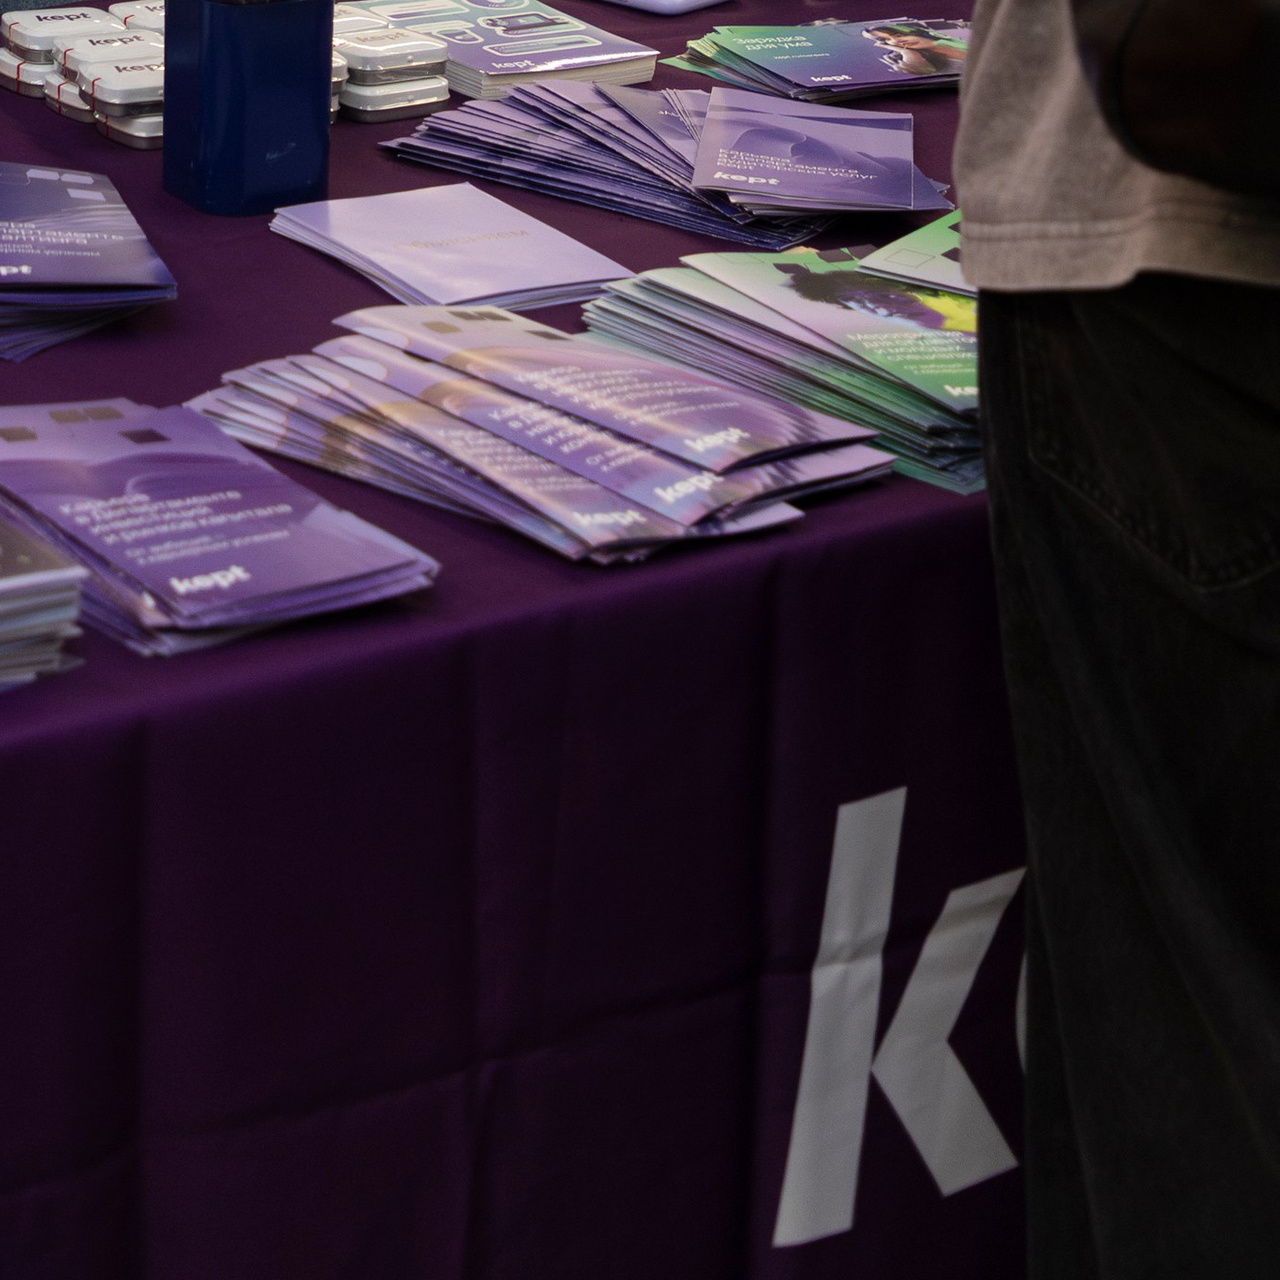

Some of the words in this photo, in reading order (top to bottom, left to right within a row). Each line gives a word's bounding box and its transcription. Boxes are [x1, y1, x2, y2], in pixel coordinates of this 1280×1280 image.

[35, 12, 91, 22] kept
[88, 35, 145, 46] kept
[491, 59, 536, 69] kept
[810, 74, 852, 82] kept
[719, 147, 791, 163] Карьера
[718, 158, 826, 176] аудиторских
[830, 171, 878, 180] услуг
[730, 154, 858, 174] Департаменте
[713, 171, 780, 186] kept
[683, 426, 750, 452] kept
[654, 471, 725, 503] kept
[572, 509, 648, 526] kept
[170, 565, 251, 594] kept
[772, 786, 1028, 1248] k
